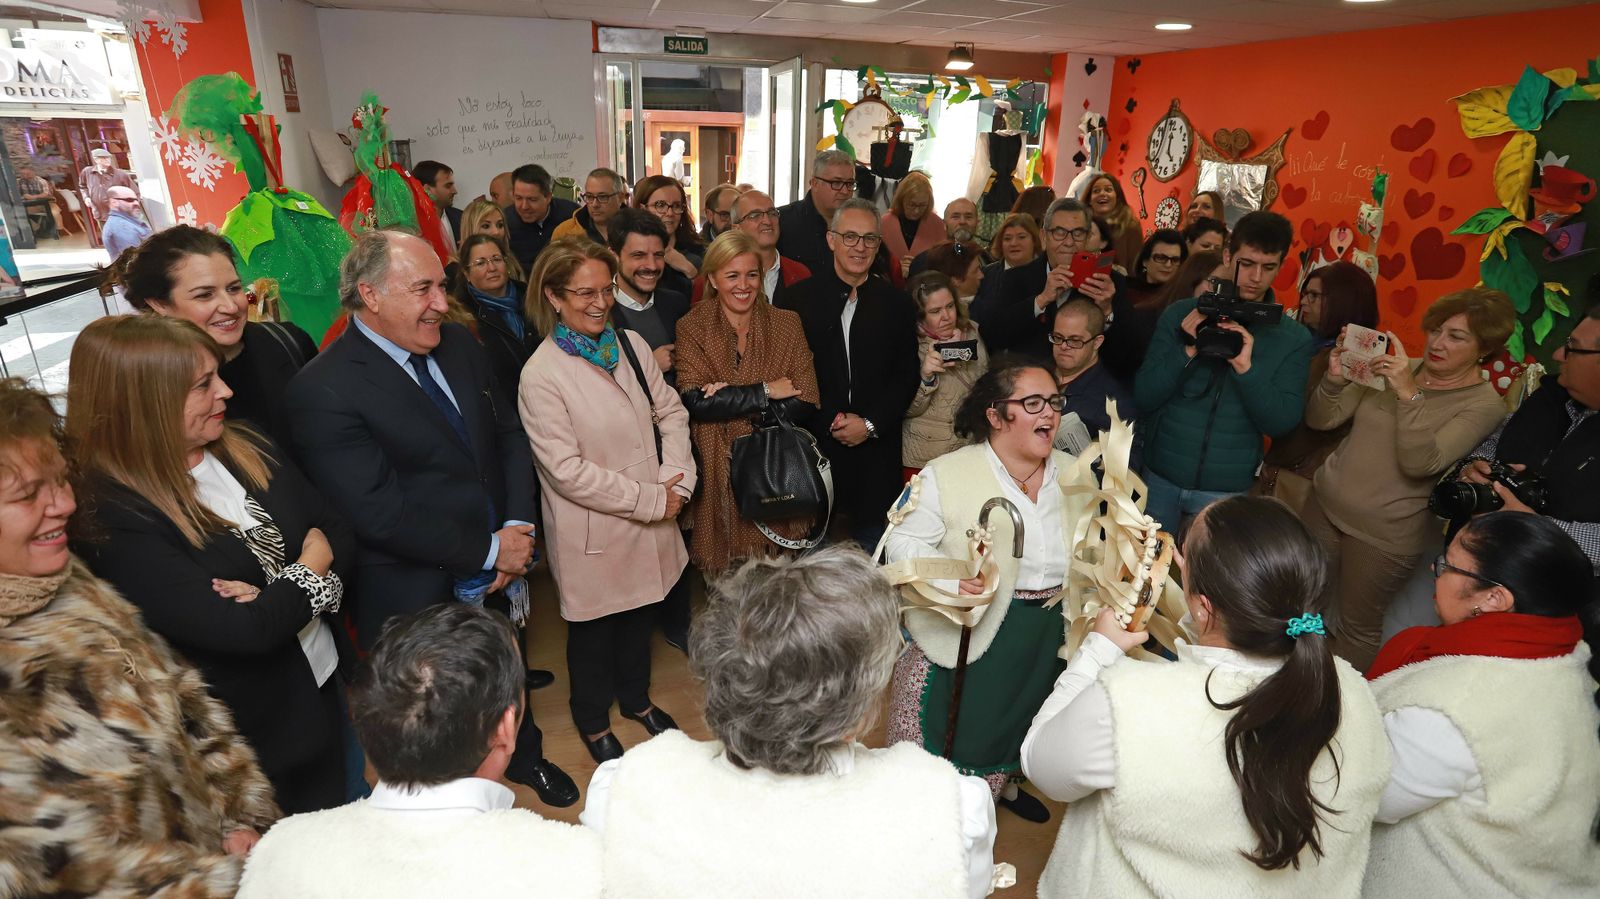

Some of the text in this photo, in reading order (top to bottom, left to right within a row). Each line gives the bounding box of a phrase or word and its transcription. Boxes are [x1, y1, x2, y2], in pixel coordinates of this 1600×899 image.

[668, 40, 704, 51] SALIDA
[4, 86, 89, 98] DELICIAS
[486, 92, 513, 117] estoy
[1169, 121, 1177, 131] 12
[458, 124, 477, 142] que
[462, 145, 474, 154] es
[526, 136, 534, 144] a
[539, 130, 548, 142] la
[773, 535, 798, 546] LOLA
